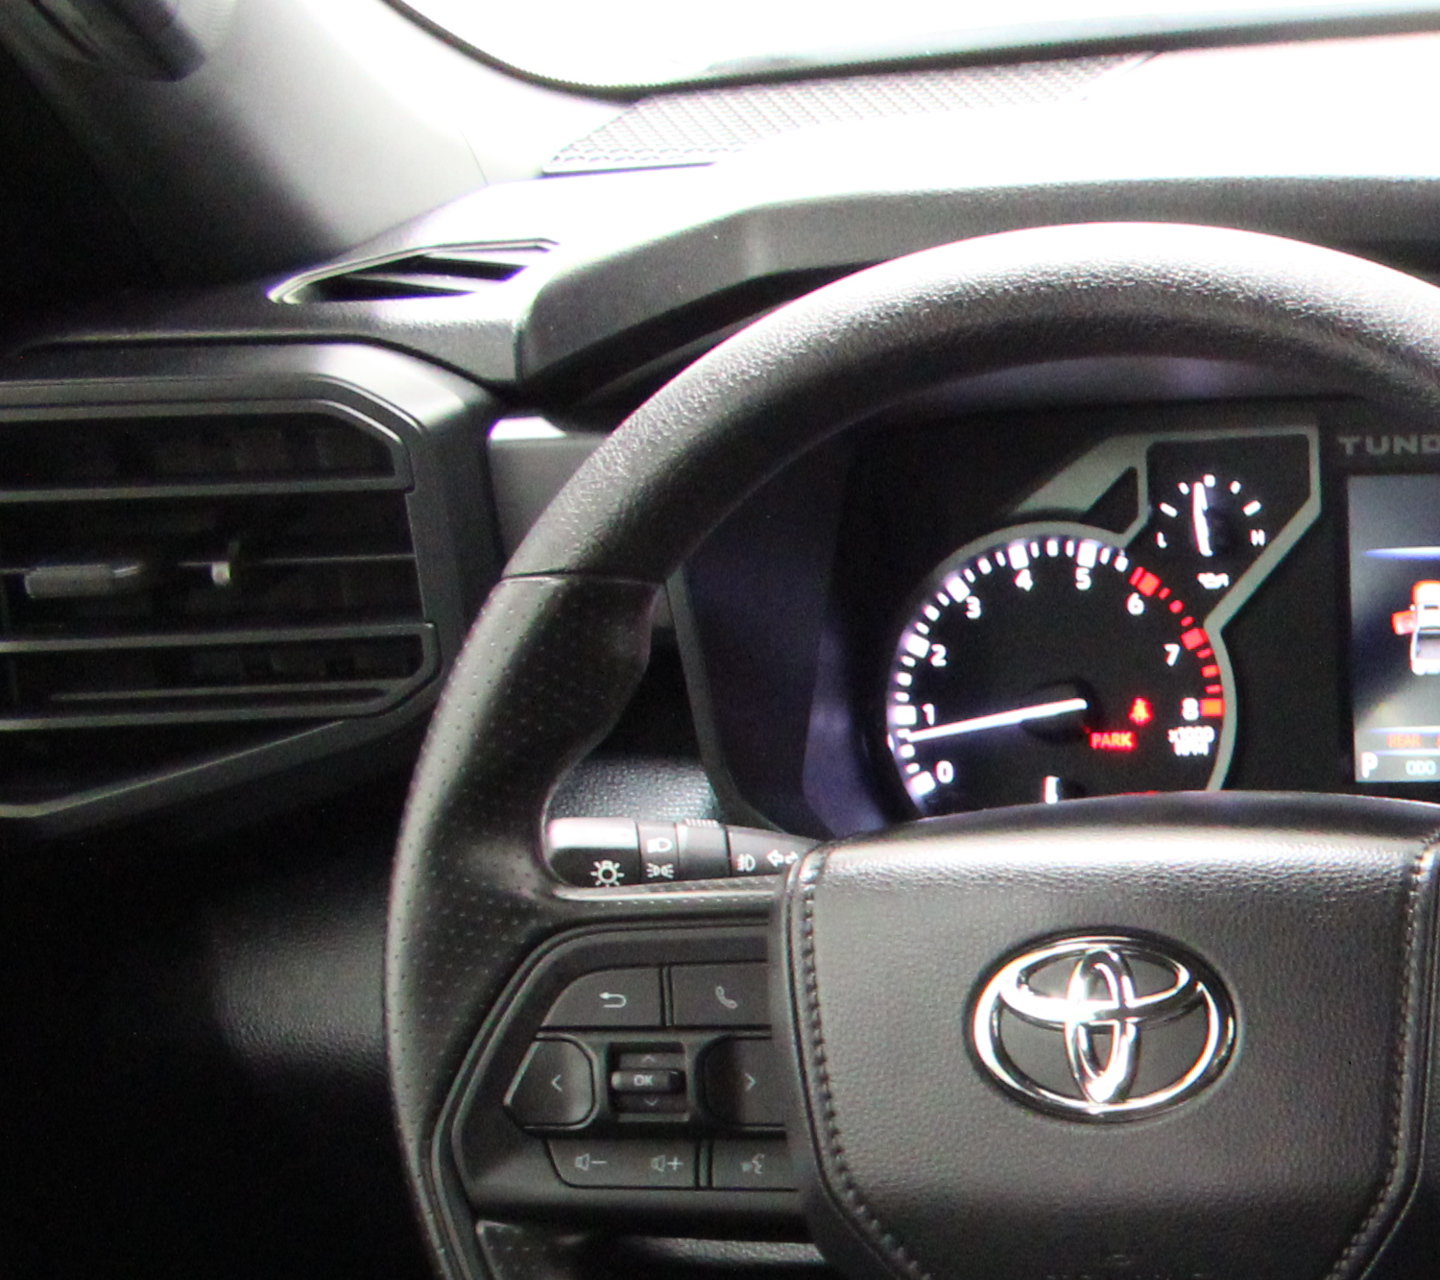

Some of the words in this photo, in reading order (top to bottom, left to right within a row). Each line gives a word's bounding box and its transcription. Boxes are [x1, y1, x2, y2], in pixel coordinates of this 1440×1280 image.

[1157, 532, 1167, 547] L
[1249, 530, 1266, 546] H
[1014, 569, 1033, 592] 4
[1075, 568, 1091, 590] 5
[965, 596, 982, 619] 3
[1126, 594, 1145, 616] 6
[929, 645, 948, 667] 2
[1164, 644, 1180, 665] 7
[923, 703, 935, 725] 1
[1182, 697, 1200, 721] 8
[1089, 730, 1136, 751] PARK
[936, 761, 954, 783] 0
[1360, 752, 1379, 779] P
[632, 1073, 654, 1088] OK
